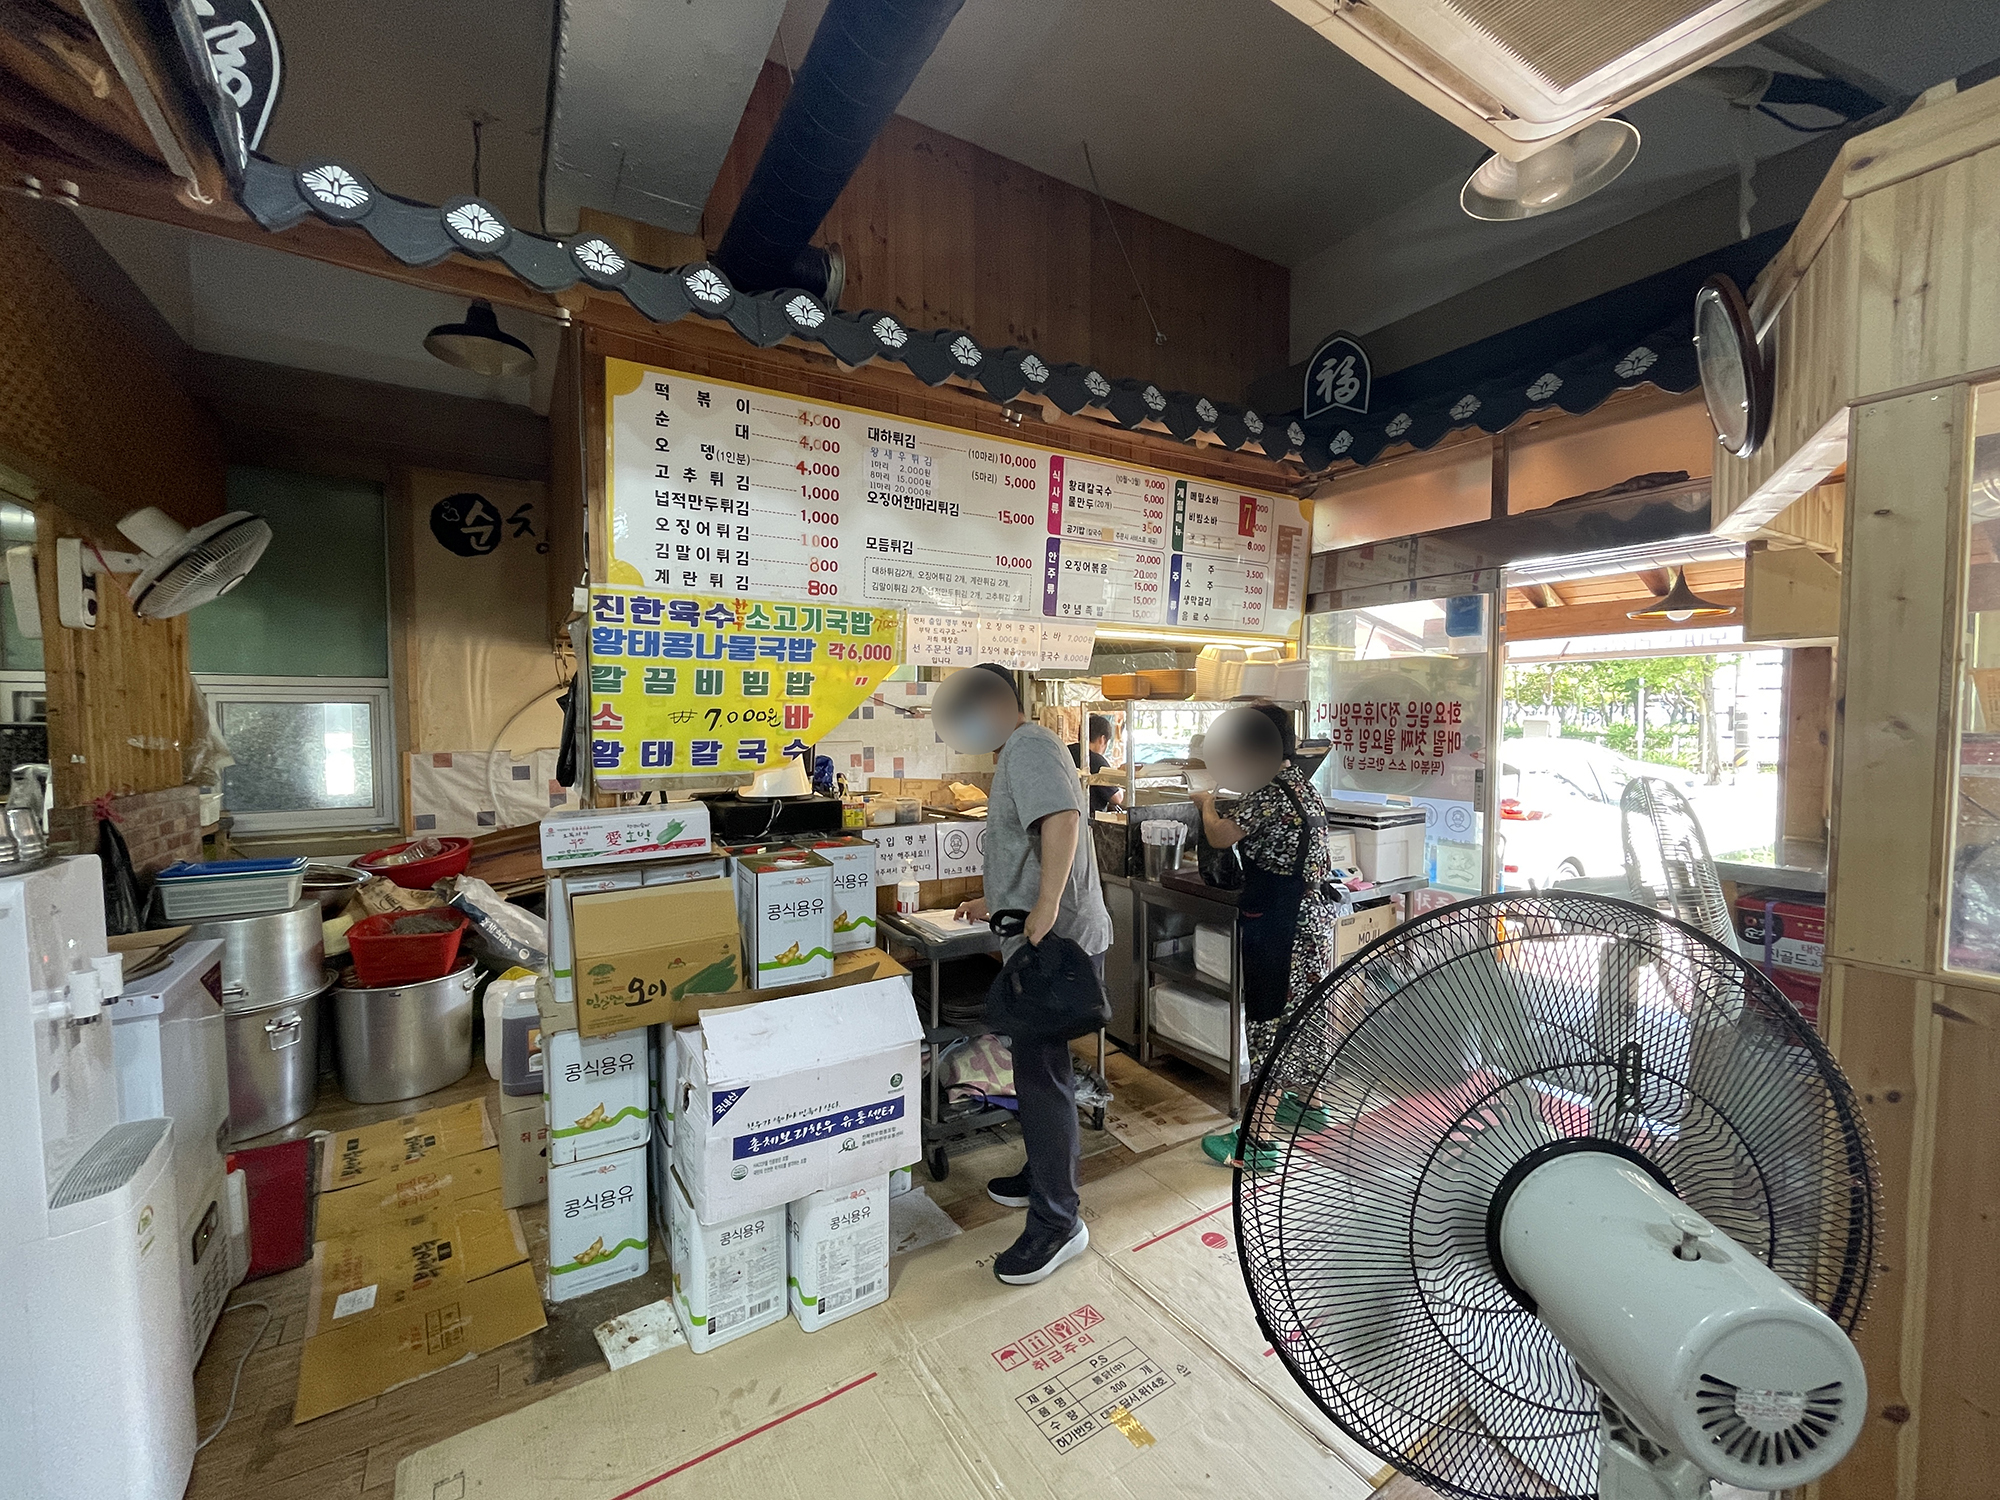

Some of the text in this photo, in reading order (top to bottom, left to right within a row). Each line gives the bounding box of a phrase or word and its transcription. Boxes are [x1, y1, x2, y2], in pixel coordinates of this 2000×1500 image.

[1316, 355, 1360, 404] 福
[799, 410, 840, 429] 4,000
[867, 427, 1037, 470] 대하튀김 (10마리) 10,000
[796, 459, 840, 478] 4,000
[871, 460, 889, 471] 1마리
[870, 470, 890, 481] 8마리
[971, 469, 1036, 491] (5마리) 5,000
[800, 485, 839, 502] 1,000
[1068, 480, 1165, 505] 황태칼국수 6,000
[800, 509, 839, 526] 1,000
[867, 491, 1035, 526] 오징어한마리튀김 15,000
[1143, 508, 1163, 519] 5,000
[866, 537, 1032, 569] 모듬튀김 10,000
[1136, 554, 1161, 565] 20,000
[810, 556, 838, 573] 800
[1065, 560, 1108, 575] 오징어볶음
[918, 570, 952, 582] 오징어튀김
[1246, 569, 1264, 580] 3,500
[808, 579, 838, 596] 800
[872, 581, 908, 594] 김말이튀김
[1134, 582, 1158, 592] 15,000
[1244, 585, 1263, 595] 3,500
[592, 594, 736, 629] 진한육수
[1242, 601, 1261, 610] 3,000
[746, 603, 874, 636] 소고기국밥
[592, 626, 816, 663] 황태콩나물국밥
[880, 852, 894, 861] 작성
[834, 872, 868, 889] 식용유
[767, 898, 825, 921] 콩식용유
[625, 976, 667, 1007] 오이
[565, 1053, 635, 1083] 콩식용유
[714, 1091, 738, 1114] 국내산
[840, 1105, 895, 1128] 유통센터
[564, 1185, 635, 1219] 콩식용유
[829, 1206, 871, 1231] 콩식용유
[720, 1220, 765, 1246] 콩식용유
[1110, 1380, 1127, 1393] 300
[1055, 1420, 1096, 1448] 허가번호
